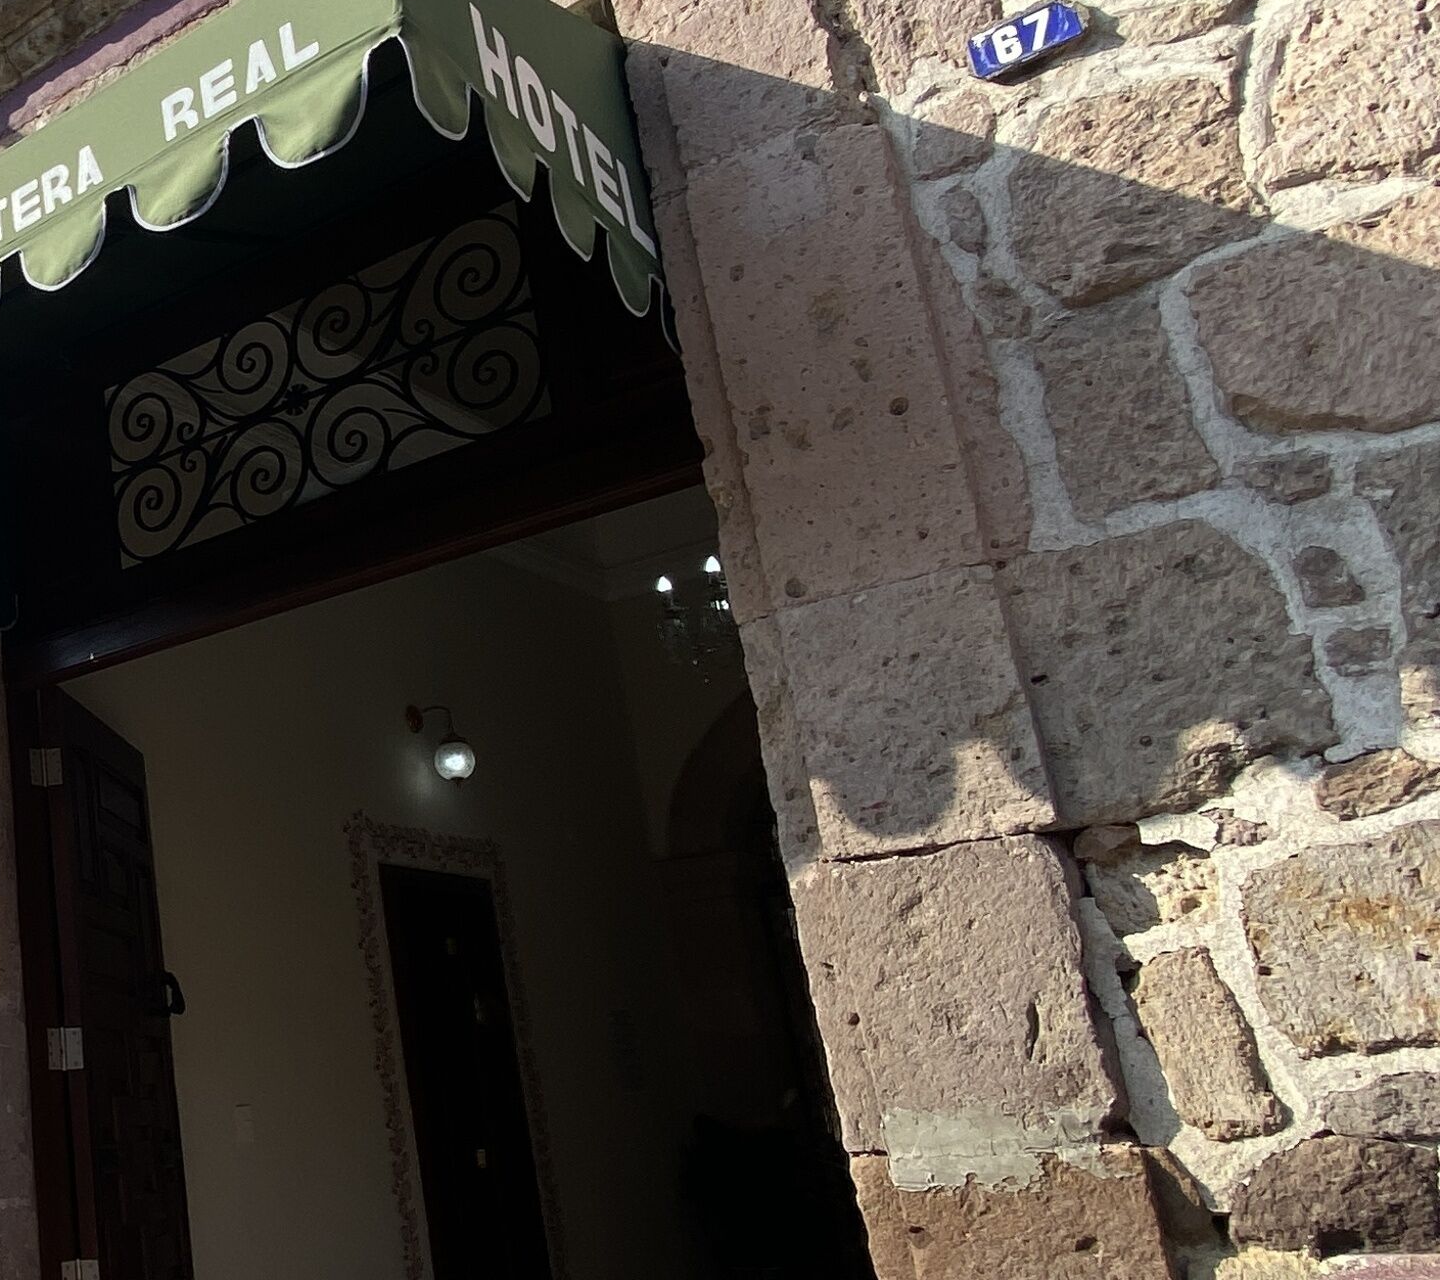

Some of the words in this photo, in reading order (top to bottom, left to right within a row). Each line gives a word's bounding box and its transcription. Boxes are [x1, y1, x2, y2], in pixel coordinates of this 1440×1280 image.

[161, 22, 320, 142] REAL
[991, 7, 1050, 64] 67
[466, 1, 657, 259] HOTEL
